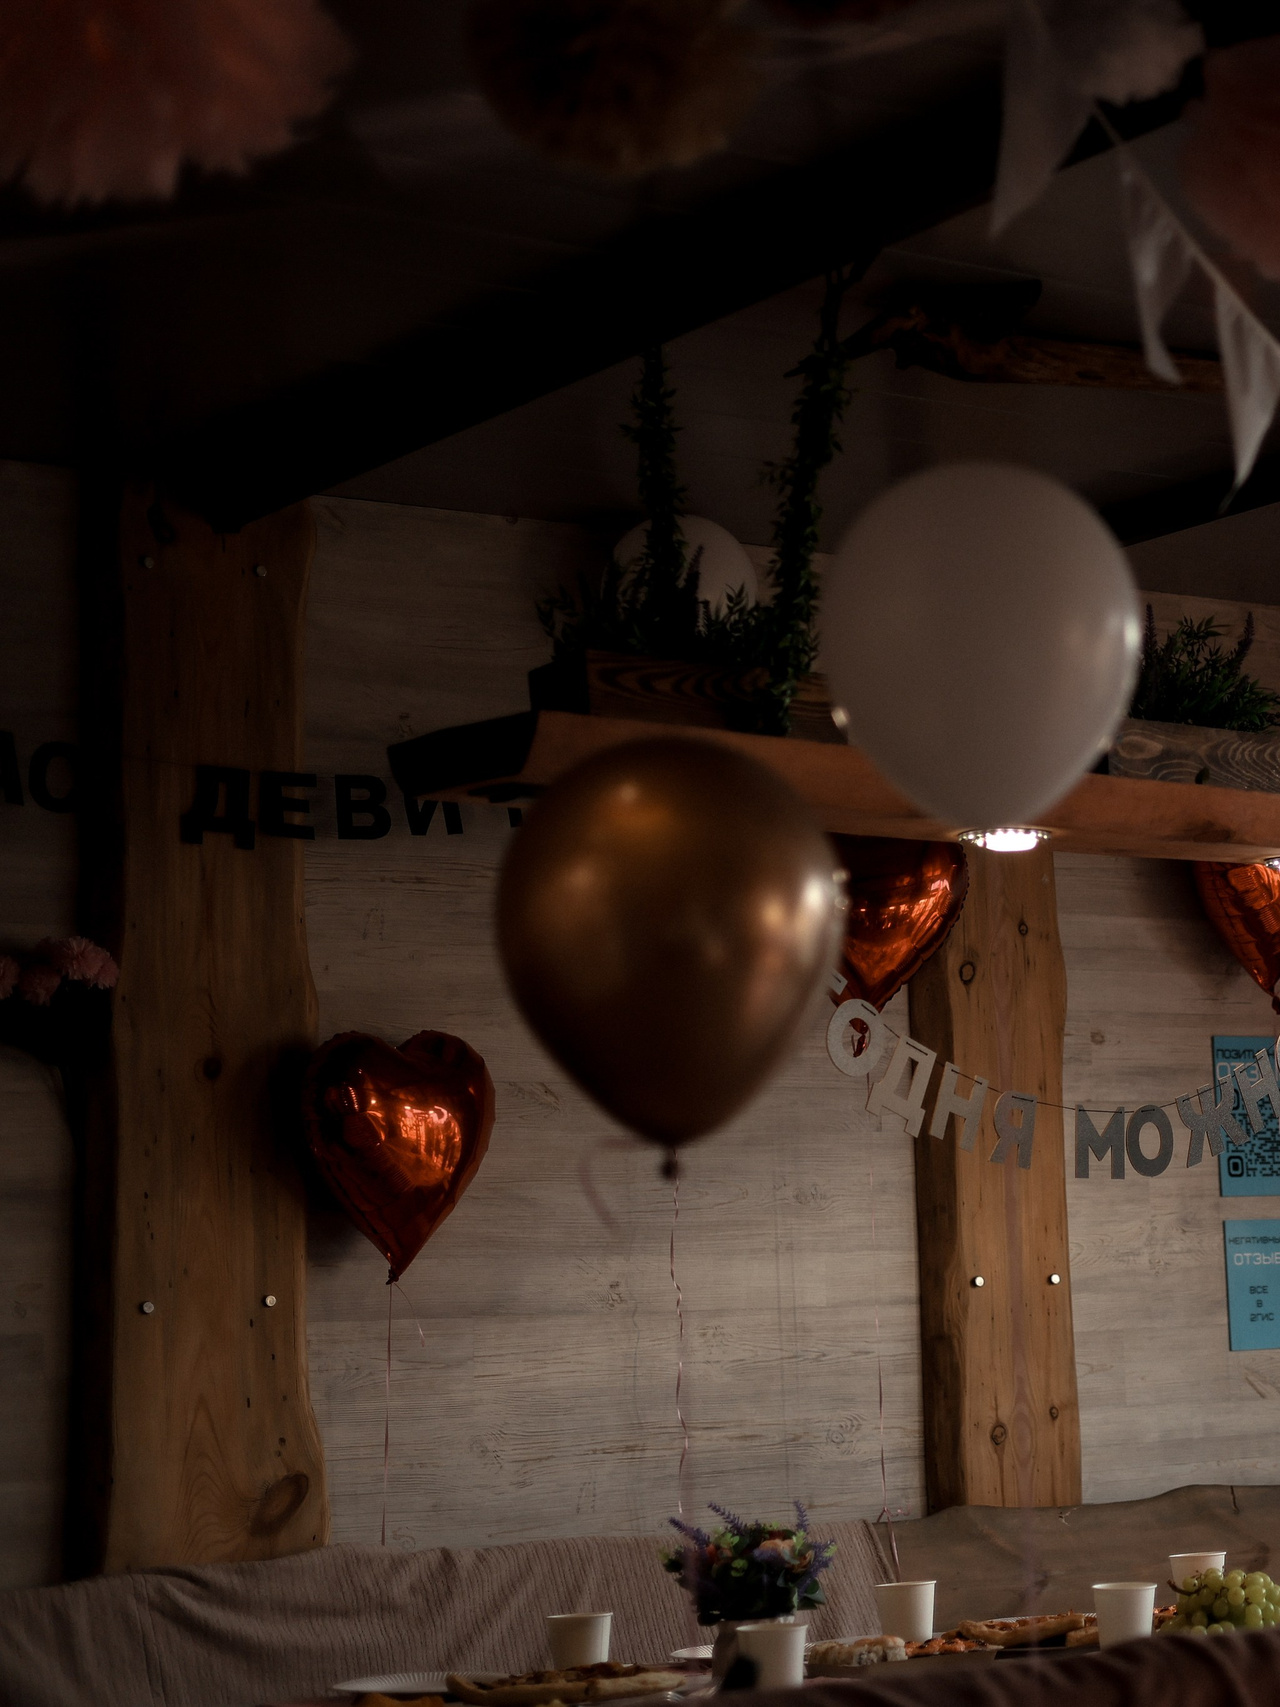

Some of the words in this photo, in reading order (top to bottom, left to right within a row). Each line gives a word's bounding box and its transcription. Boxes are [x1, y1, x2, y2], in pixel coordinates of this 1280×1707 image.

[181, 765, 524, 850] ДЕВИ
[1249, 1286, 1269, 1295] ВСЕ
[1256, 1300, 1263, 1308] В
[1250, 1313, 1275, 1322] 2ГИС
